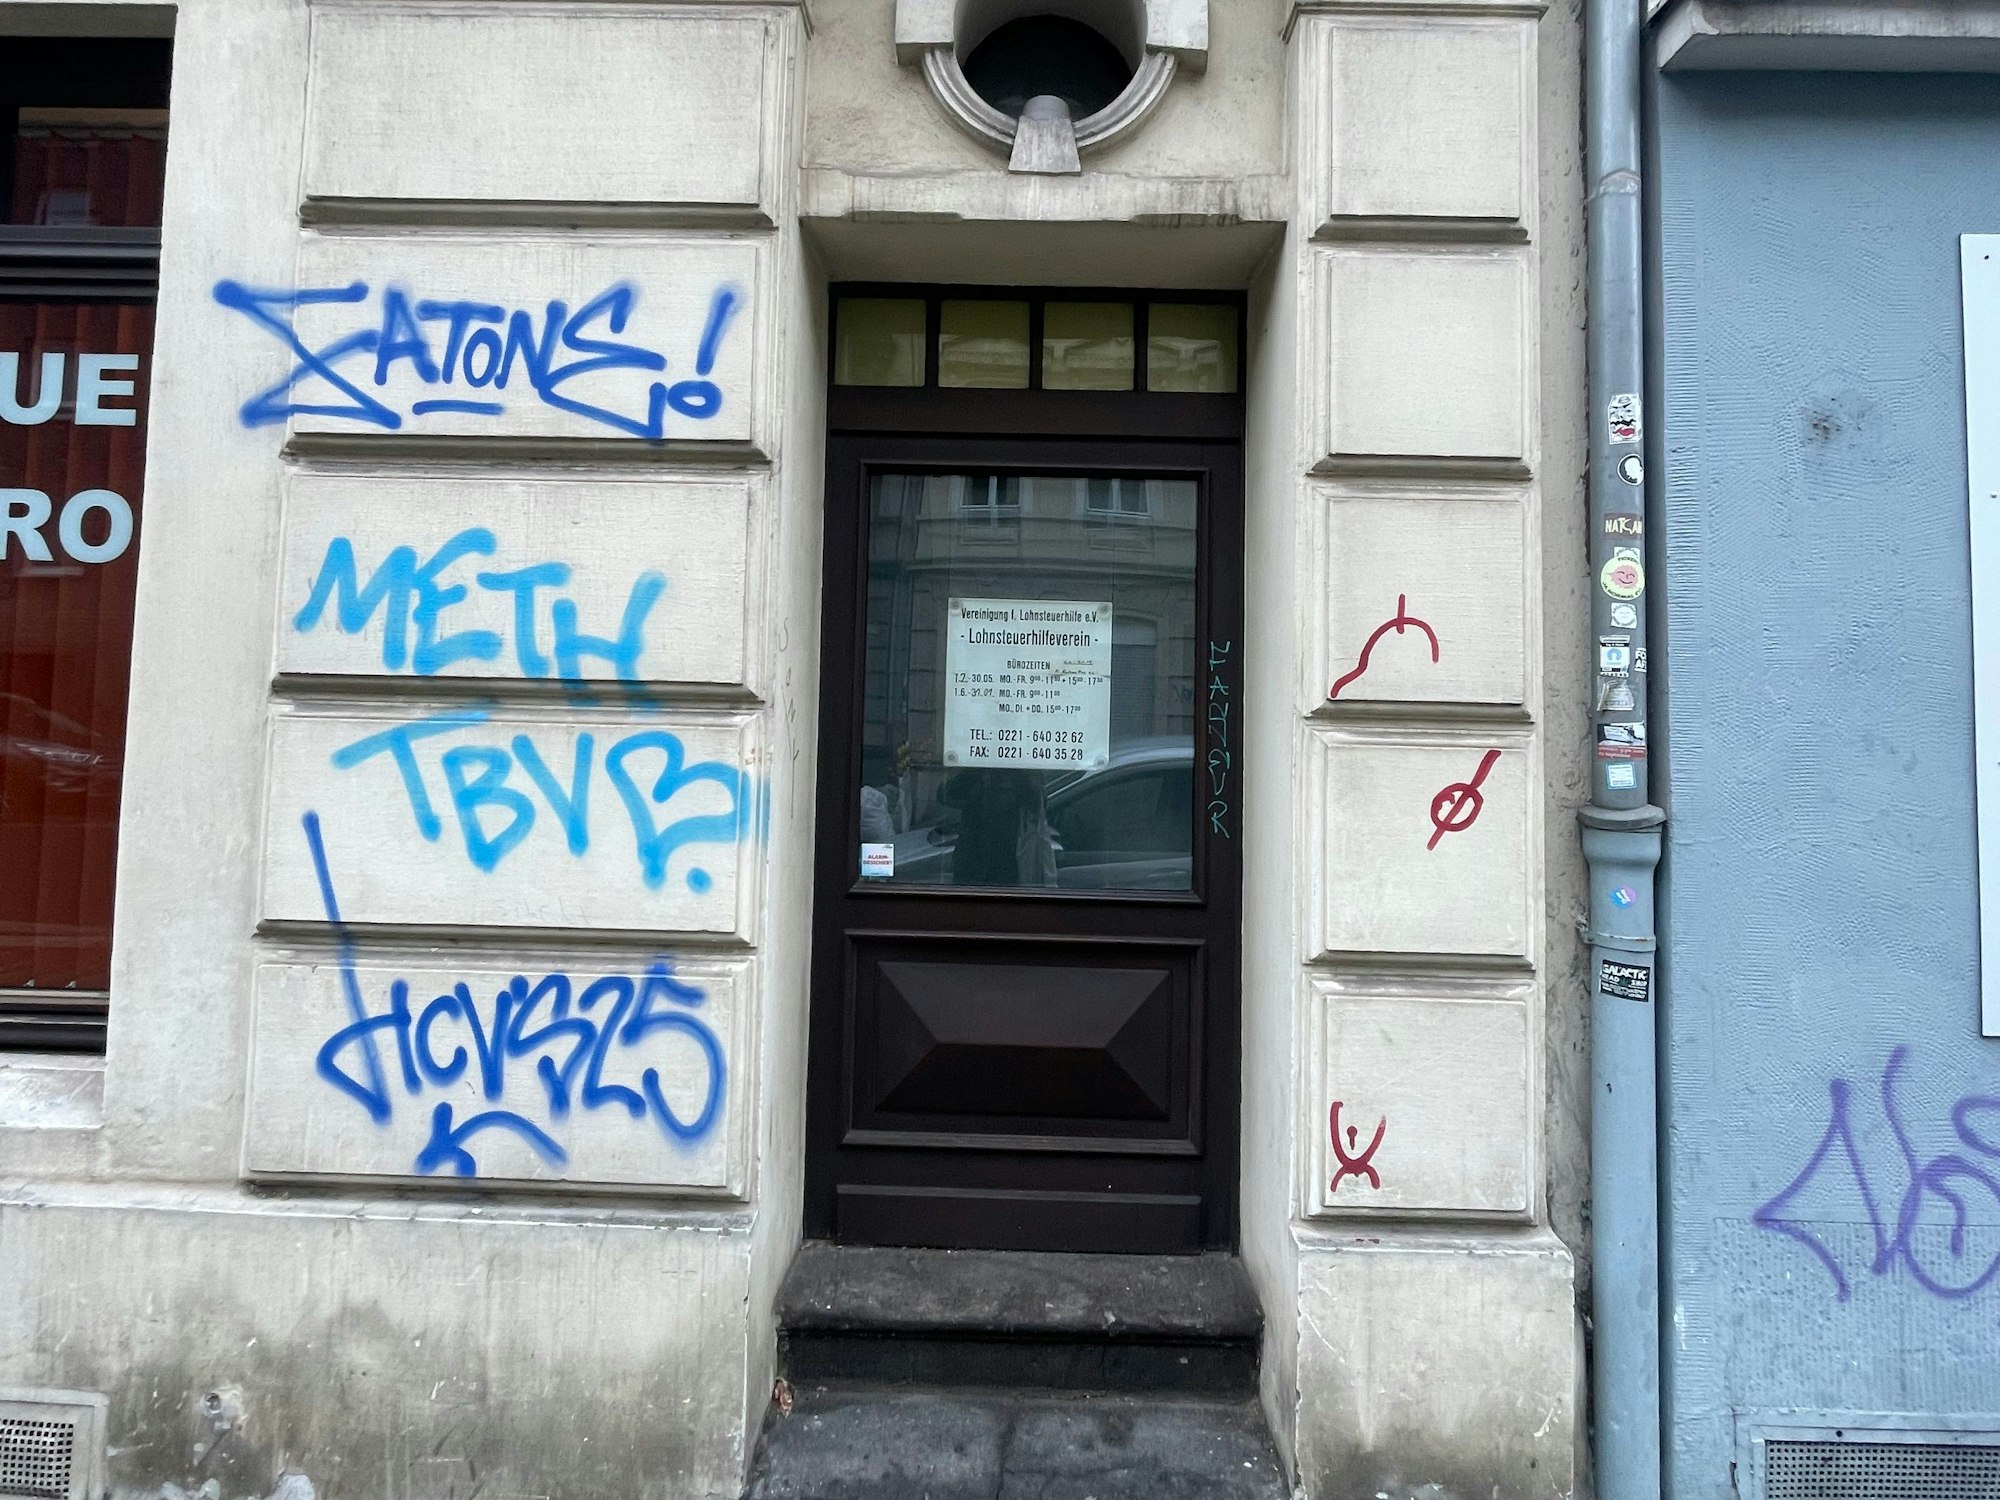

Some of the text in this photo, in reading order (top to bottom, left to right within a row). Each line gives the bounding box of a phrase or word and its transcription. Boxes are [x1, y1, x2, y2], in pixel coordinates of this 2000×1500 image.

[0, 352, 140, 426] UE
[0, 487, 135, 564] RO
[961, 607, 1099, 623] Vereinigung f. Lohnsteuerhilfe e.V.
[969, 628, 1090, 647] Lohnsteuerhilfeverein
[1007, 658, 1050, 670] BÜROZEITEN
[998, 729, 1022, 741] 0221
[1032, 730, 1051, 742] 640
[1055, 731, 1067, 743] 32
[1071, 731, 1084, 743] 62
[969, 745, 989, 757] FAX:
[998, 746, 1022, 759] 0221
[1032, 747, 1051, 760] 640
[1054, 748, 1067, 760] 35
[1070, 748, 1083, 761] 28
[1602, 963, 1648, 981] GALACTIC
